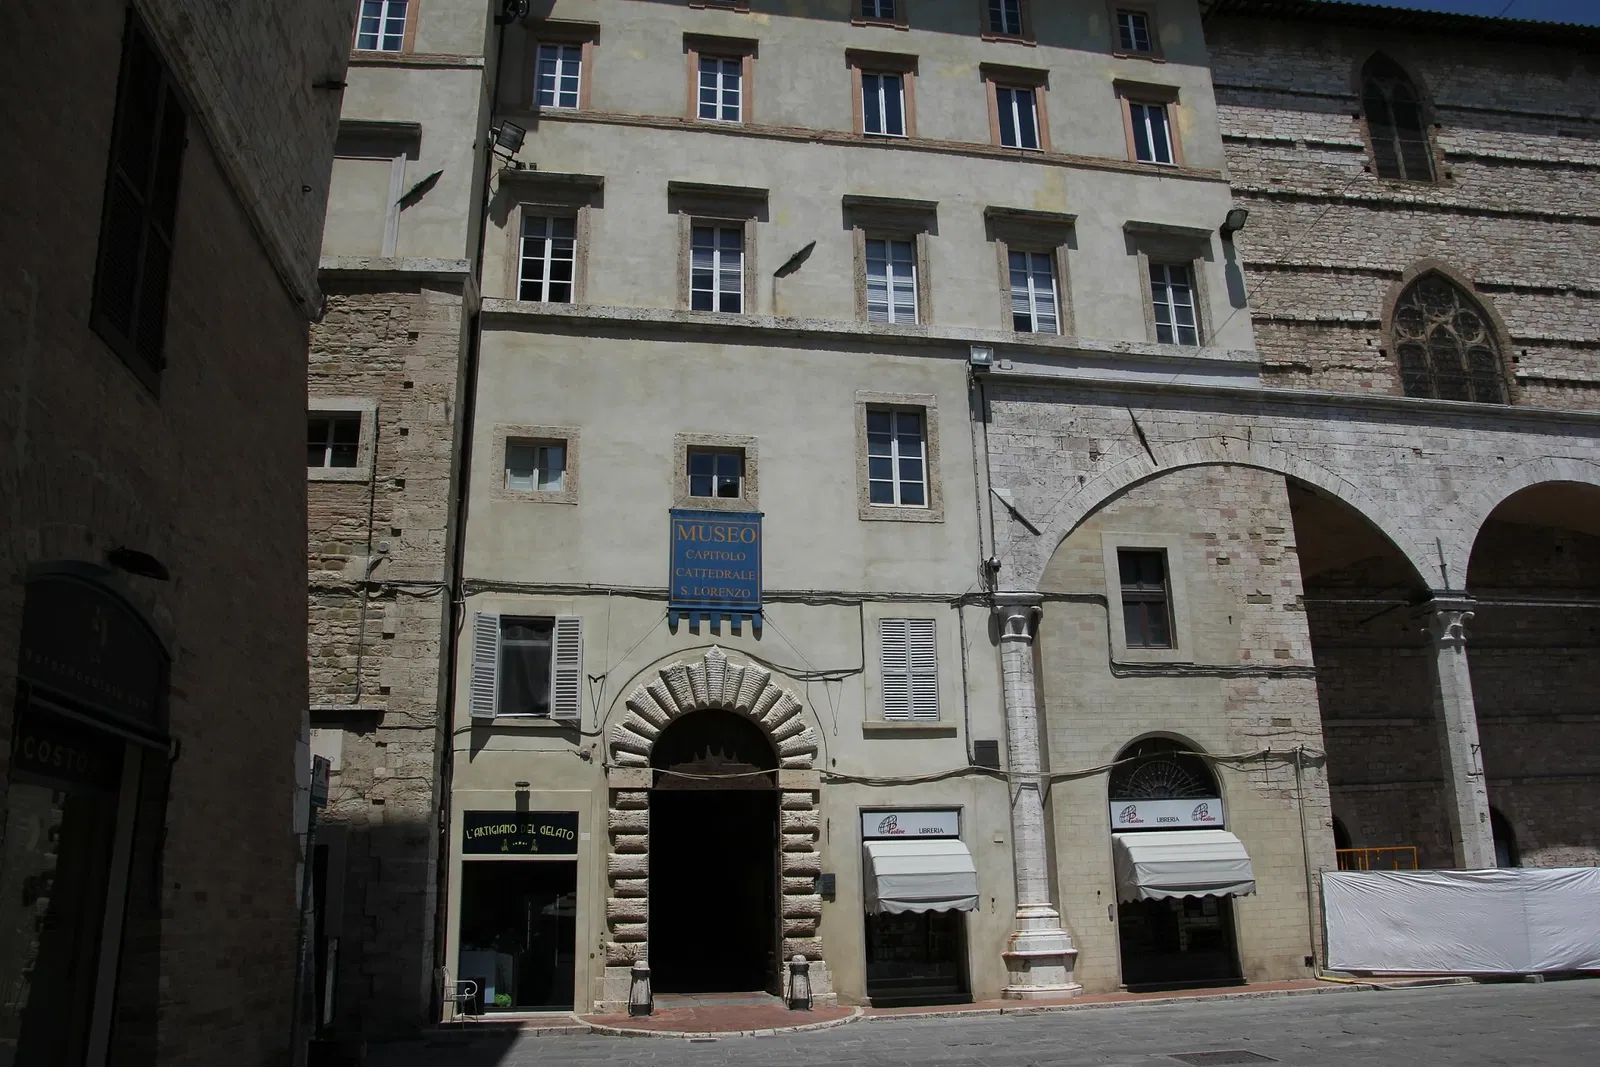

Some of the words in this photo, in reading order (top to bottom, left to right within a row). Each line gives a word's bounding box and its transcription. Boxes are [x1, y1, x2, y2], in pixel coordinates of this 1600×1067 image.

[677, 524, 757, 544] MUSEO
[685, 549, 746, 561] CAPITOLO
[675, 567, 756, 580] CATTEDRALE
[680, 585, 690, 596] S.
[694, 586, 751, 598] LORENZO
[465, 823, 518, 840] L'ARTIGIANO
[520, 823, 537, 835] DEL
[539, 824, 575, 841] GELATO
